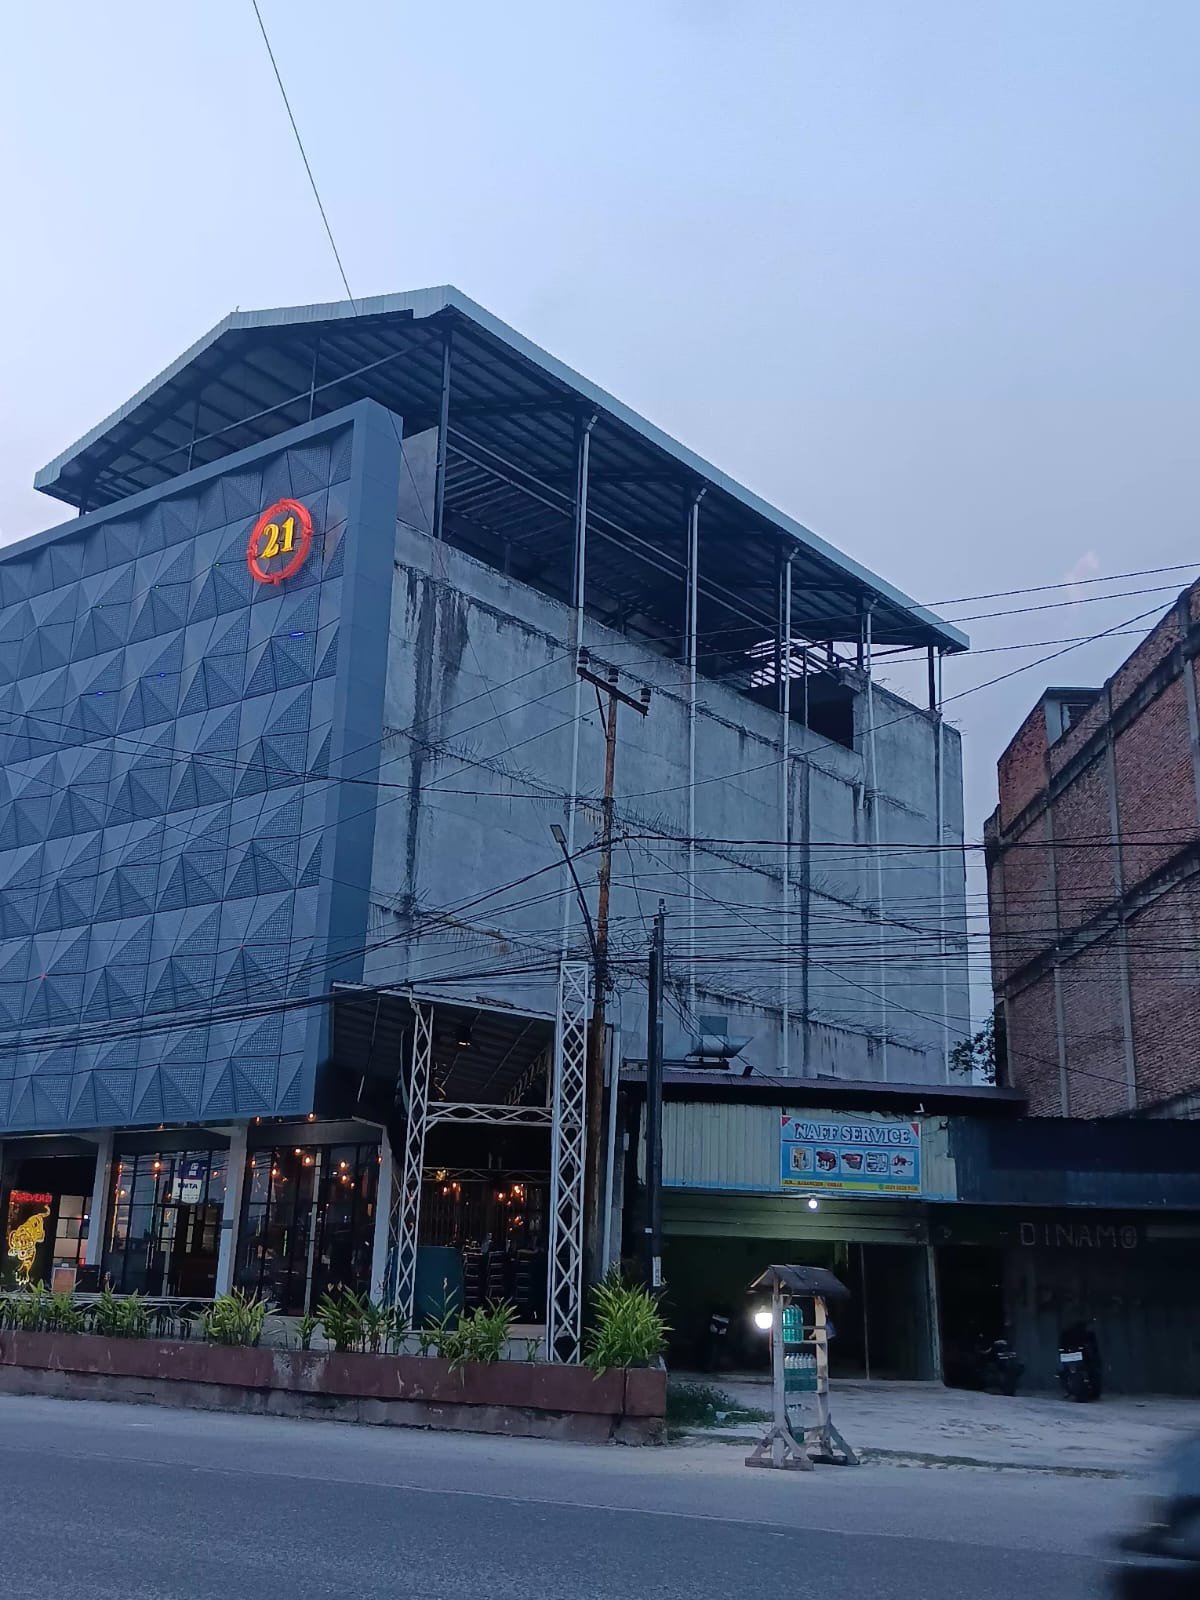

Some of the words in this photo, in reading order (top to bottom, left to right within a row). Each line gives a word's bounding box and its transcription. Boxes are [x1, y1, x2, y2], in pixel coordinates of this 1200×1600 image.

[260, 516, 295, 559] 21
[795, 1124, 839, 1140] NAFF
[841, 1127, 911, 1144] SERVICE
[1019, 1222, 1137, 1249] DINAMO
